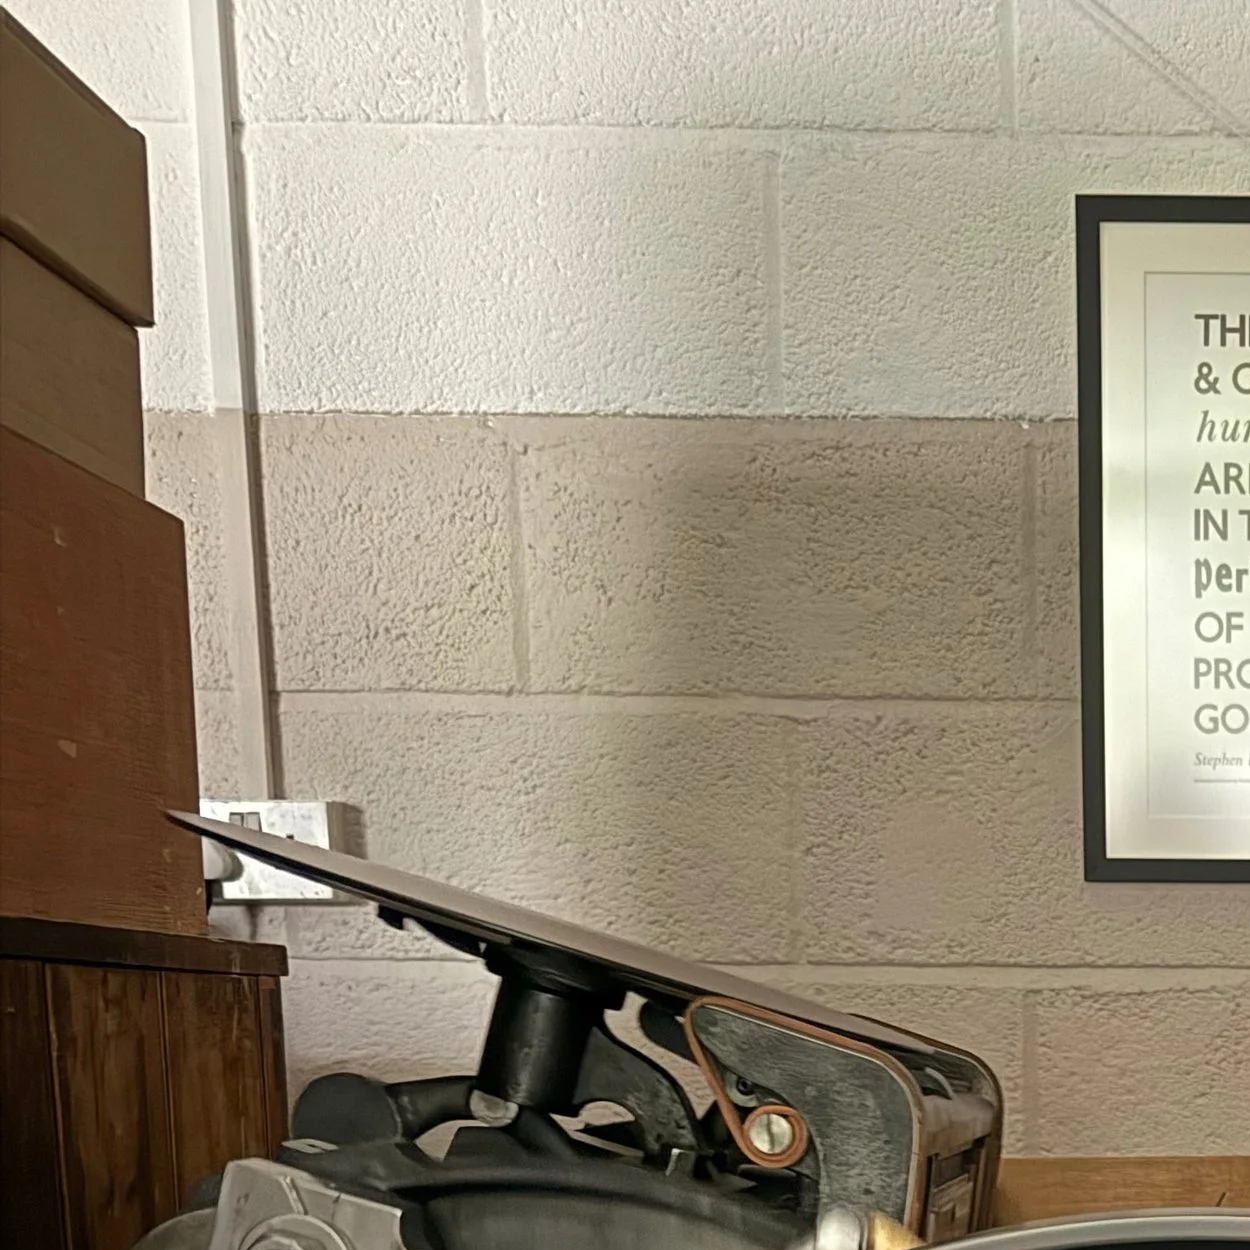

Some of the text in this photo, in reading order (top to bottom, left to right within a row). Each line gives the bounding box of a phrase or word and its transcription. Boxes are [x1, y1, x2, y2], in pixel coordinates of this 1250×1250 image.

[1194, 361, 1221, 395] &
[1194, 508, 1228, 541] IN
[1194, 611, 1244, 644] OF
[1193, 752, 1243, 771] Stephen
